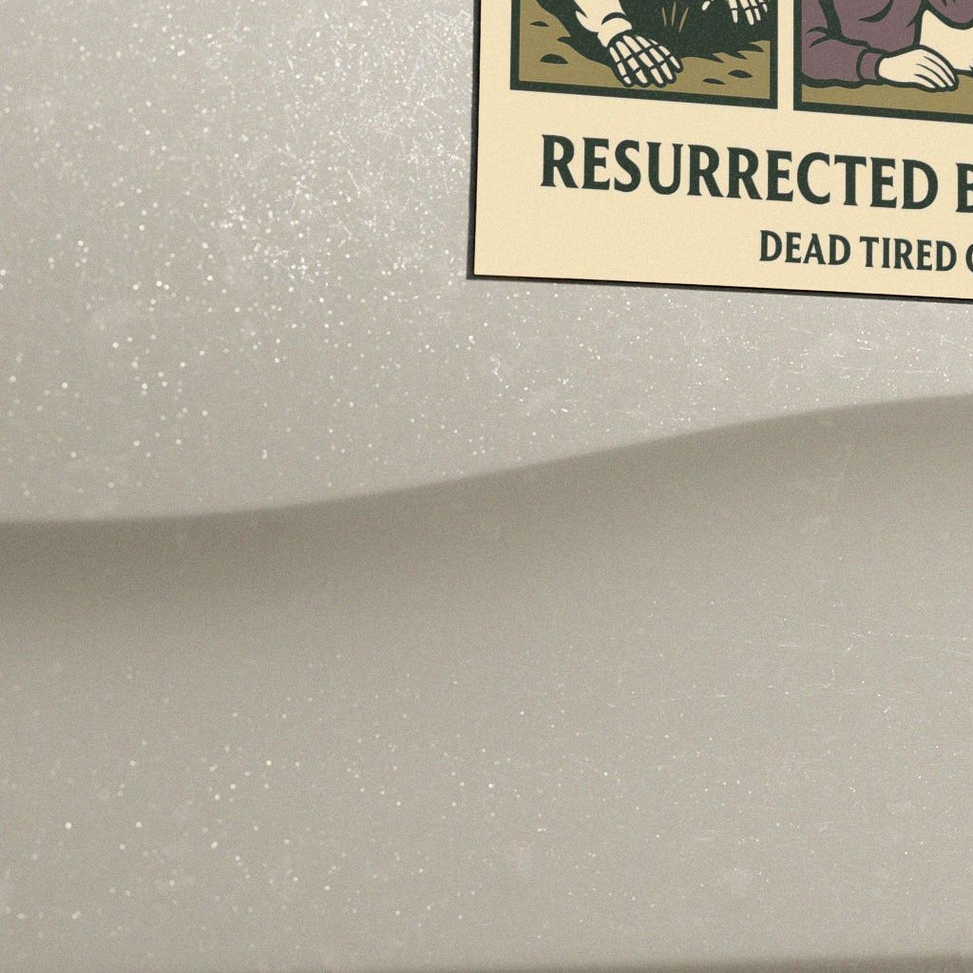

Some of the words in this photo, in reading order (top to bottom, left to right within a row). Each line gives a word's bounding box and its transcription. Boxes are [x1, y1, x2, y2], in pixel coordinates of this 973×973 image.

[541, 134, 939, 211] RESURRECTED
[759, 229, 851, 266] DEAD
[859, 235, 957, 273] TIRED
